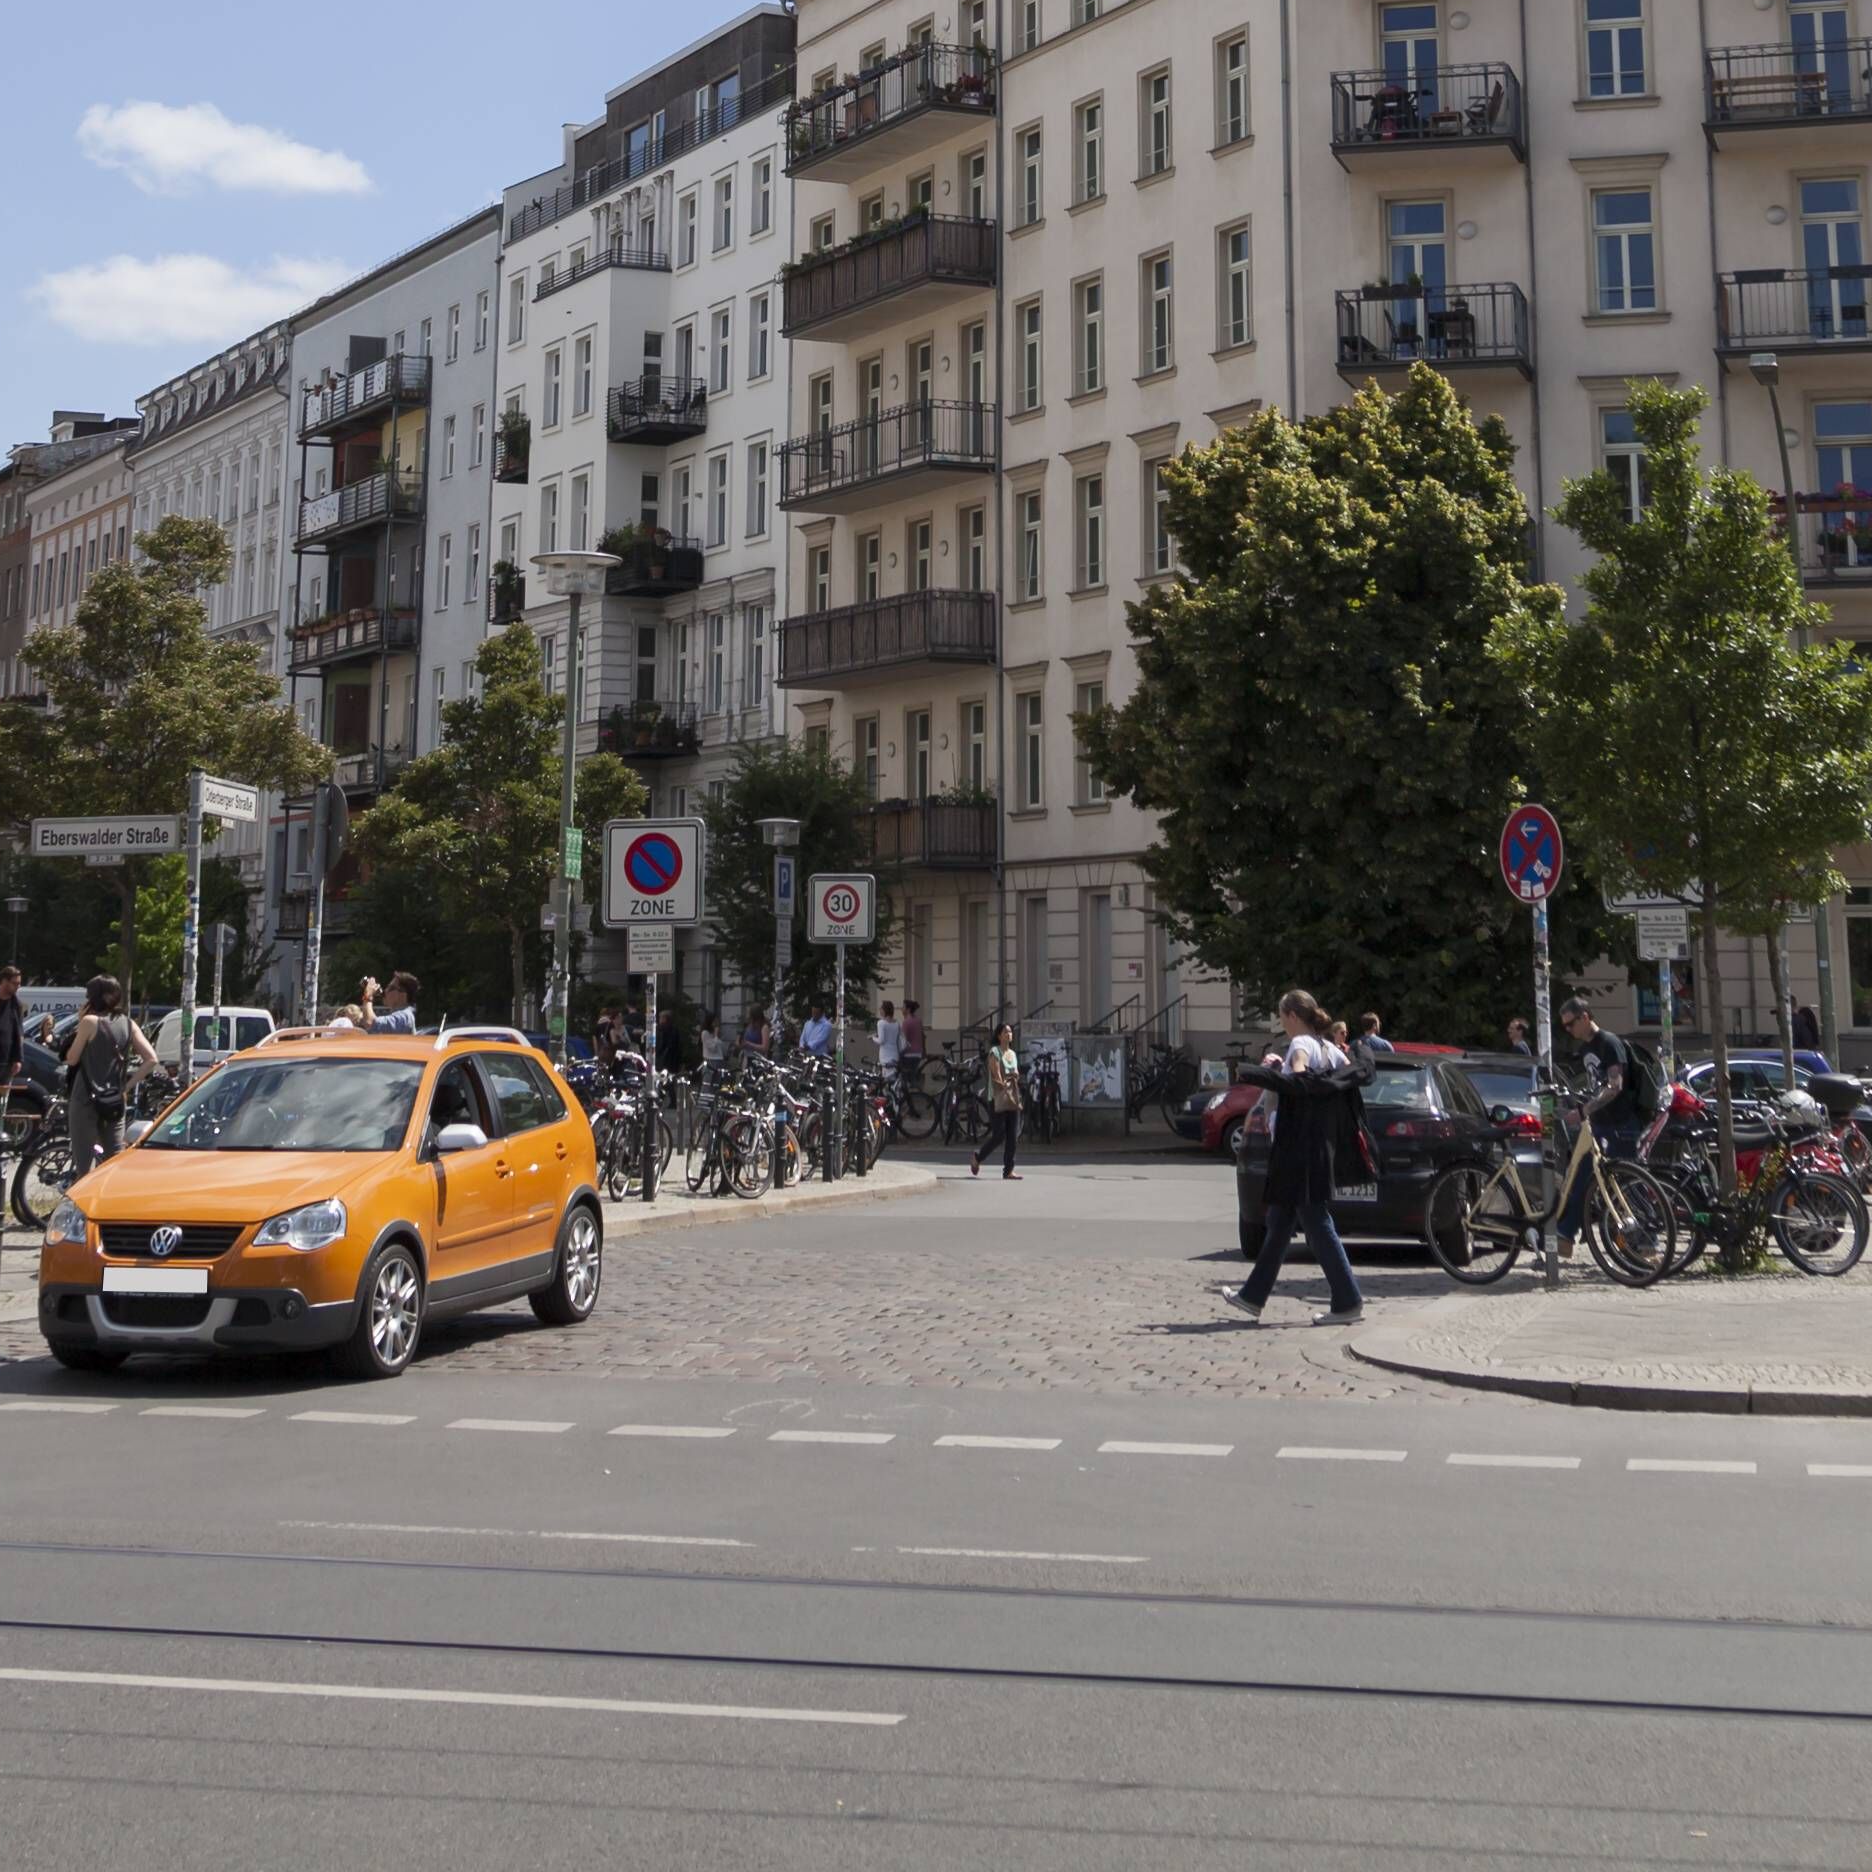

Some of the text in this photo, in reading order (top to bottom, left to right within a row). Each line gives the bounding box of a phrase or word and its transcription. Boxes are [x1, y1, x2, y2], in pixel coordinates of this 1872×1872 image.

[205, 787, 253, 812] Oderberger Straße
[41, 828, 169, 846] Eberswalder Straße
[630, 899, 675, 915] ZONE
[830, 894, 852, 913] 30
[827, 925, 855, 935] ZONE
